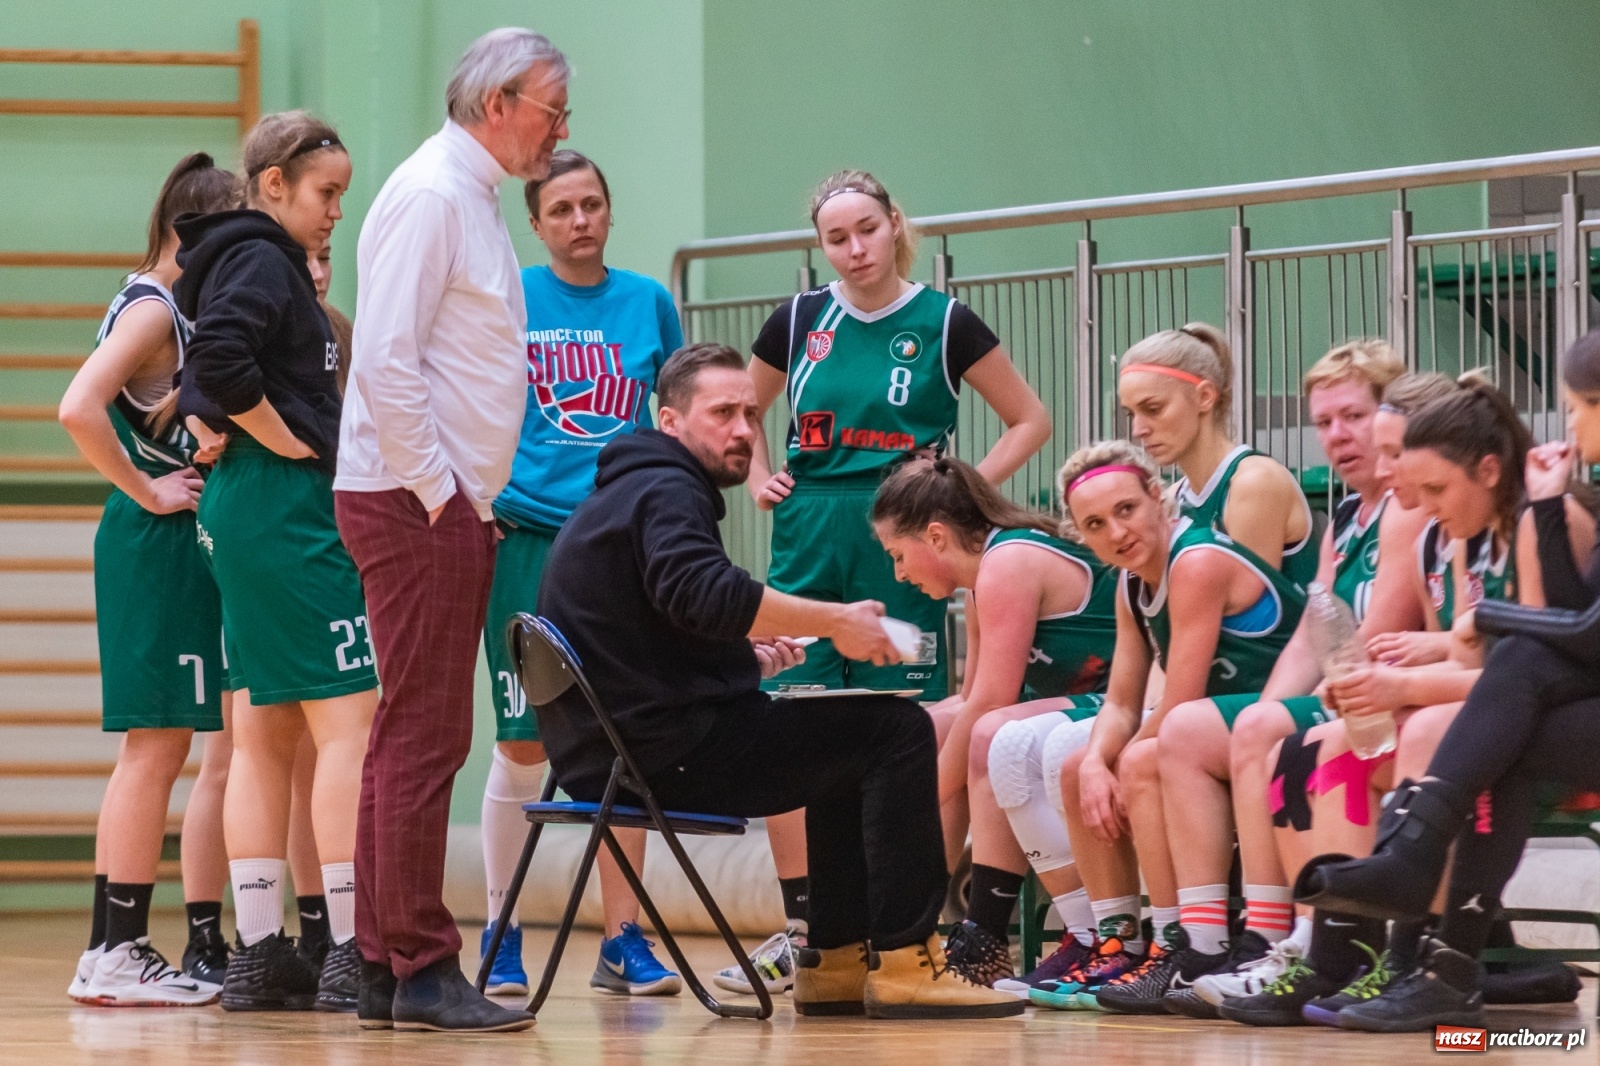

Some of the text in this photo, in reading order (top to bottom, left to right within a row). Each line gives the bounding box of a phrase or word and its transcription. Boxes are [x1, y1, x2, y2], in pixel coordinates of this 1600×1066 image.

[527, 341, 623, 386] SHOOT
[887, 366, 912, 406] 8
[591, 372, 648, 424] OUT
[329, 615, 375, 672] 23
[178, 654, 205, 705] 7
[498, 671, 527, 718] 30
